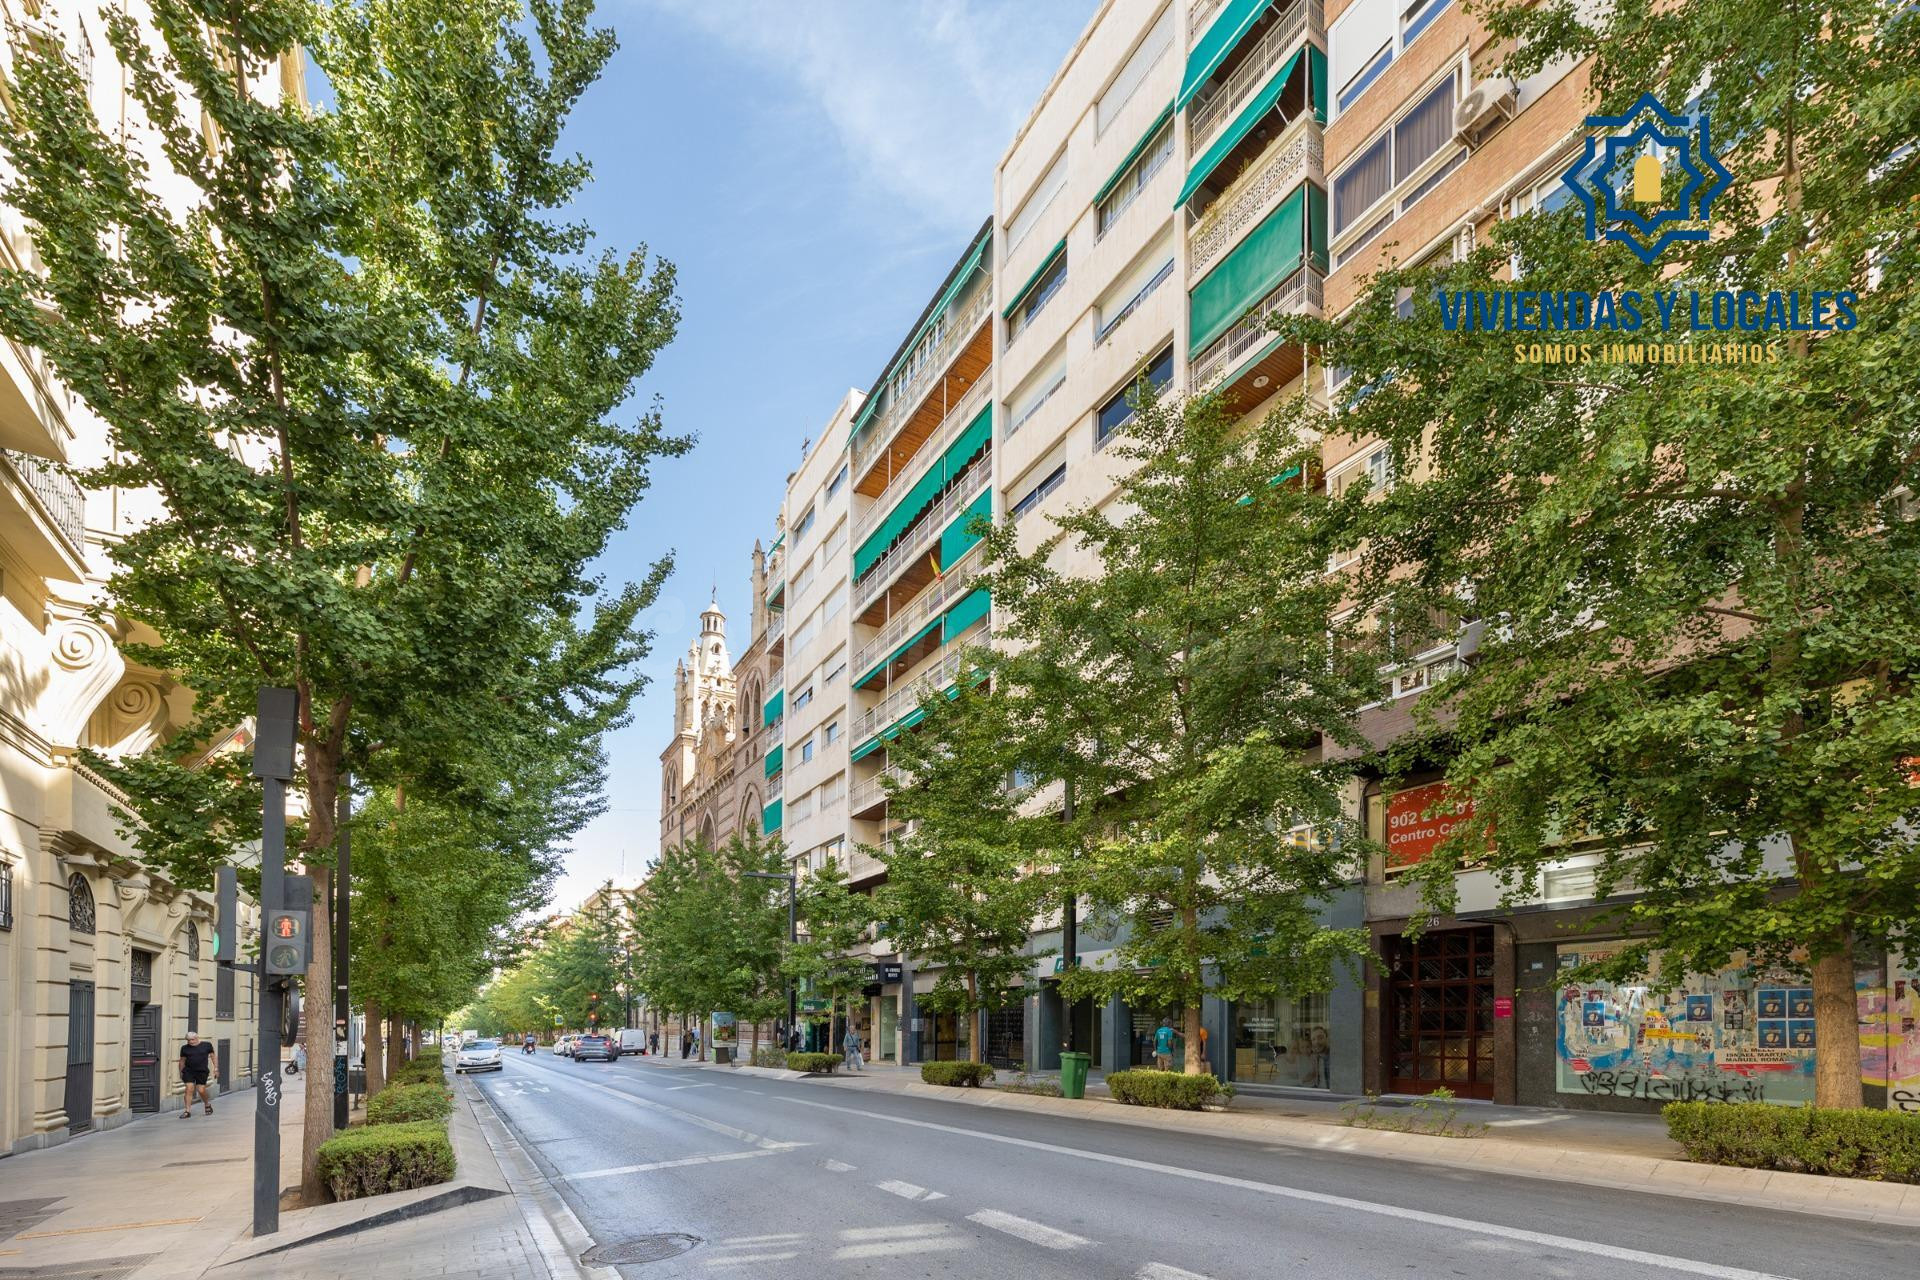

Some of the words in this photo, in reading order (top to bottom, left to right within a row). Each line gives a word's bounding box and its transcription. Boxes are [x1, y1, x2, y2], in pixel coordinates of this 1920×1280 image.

[1390, 811, 1418, 829] 902
[1390, 829, 1436, 845] Centro
[1426, 916, 1440, 928] 26
